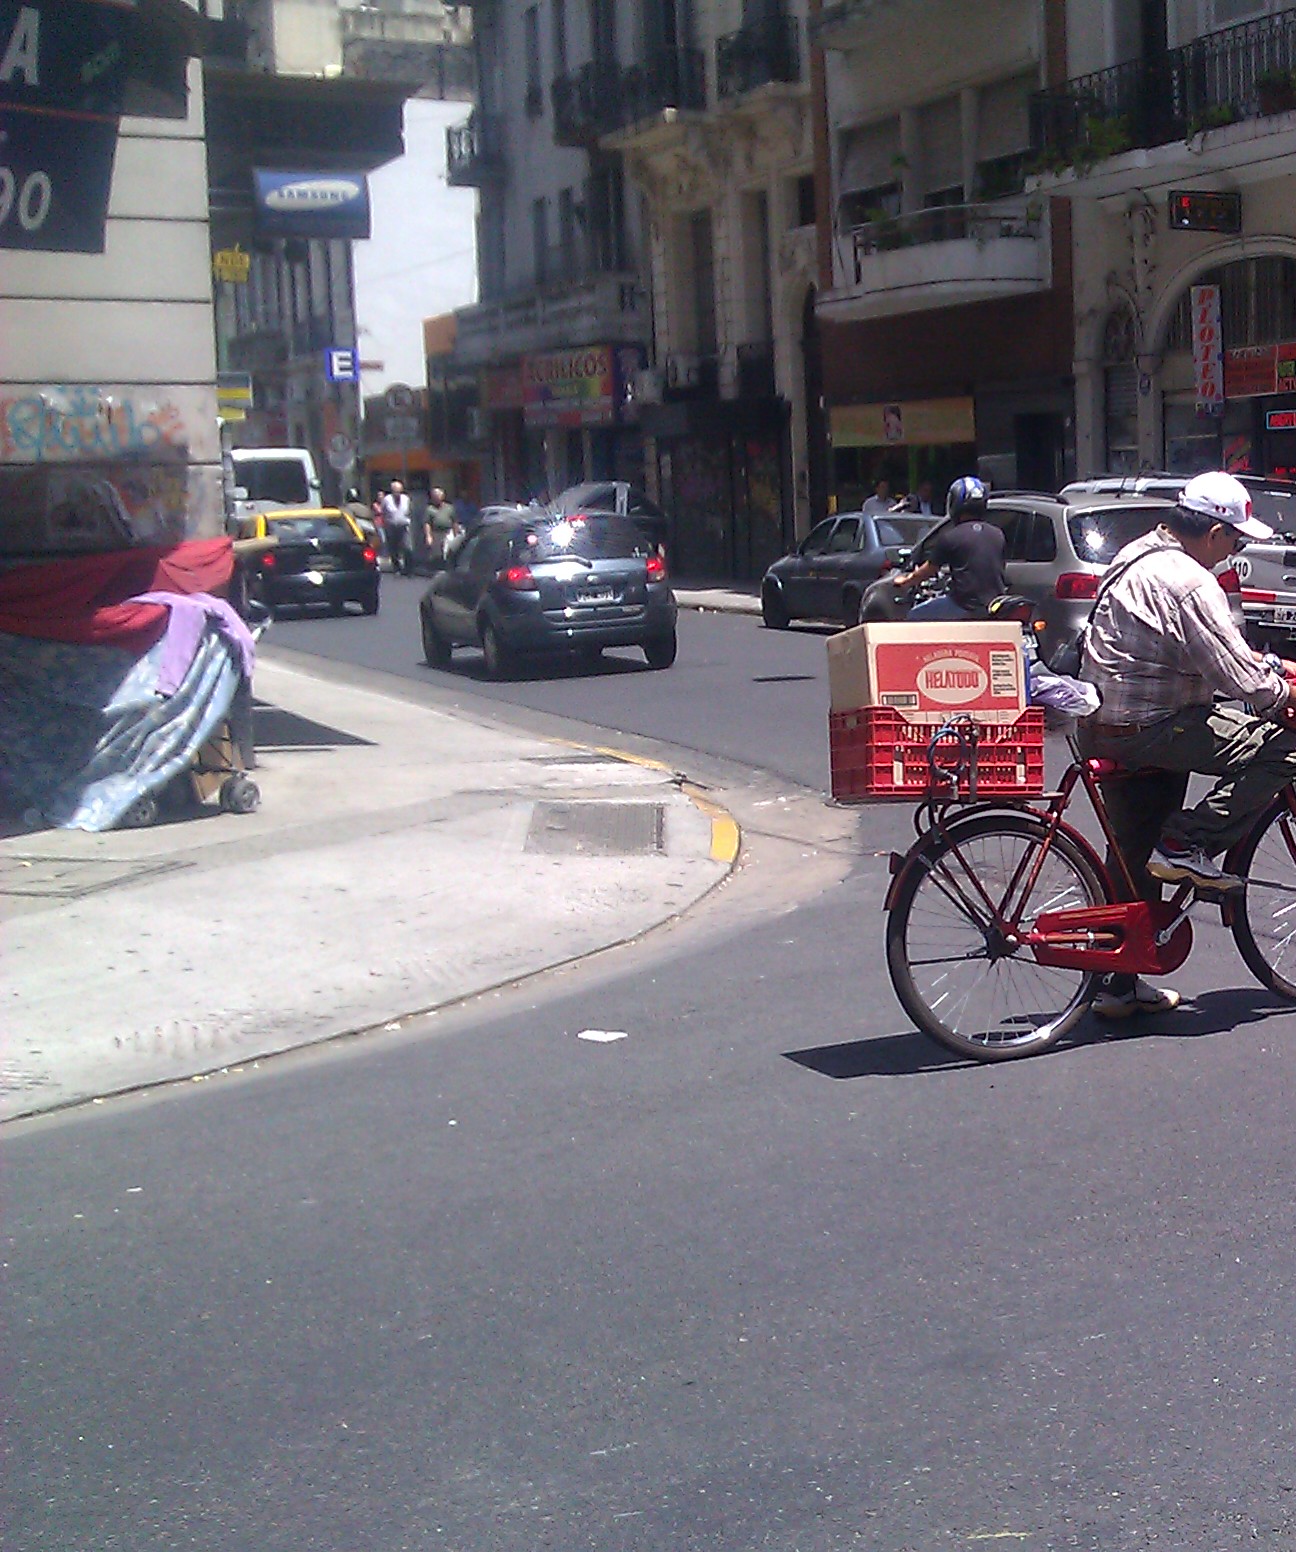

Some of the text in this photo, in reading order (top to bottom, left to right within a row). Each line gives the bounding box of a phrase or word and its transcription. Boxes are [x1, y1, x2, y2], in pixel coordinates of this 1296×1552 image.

[276, 188, 350, 201] SAMSUNG
[1197, 288, 1216, 398] PLOTEO
[331, 351, 353, 377] E
